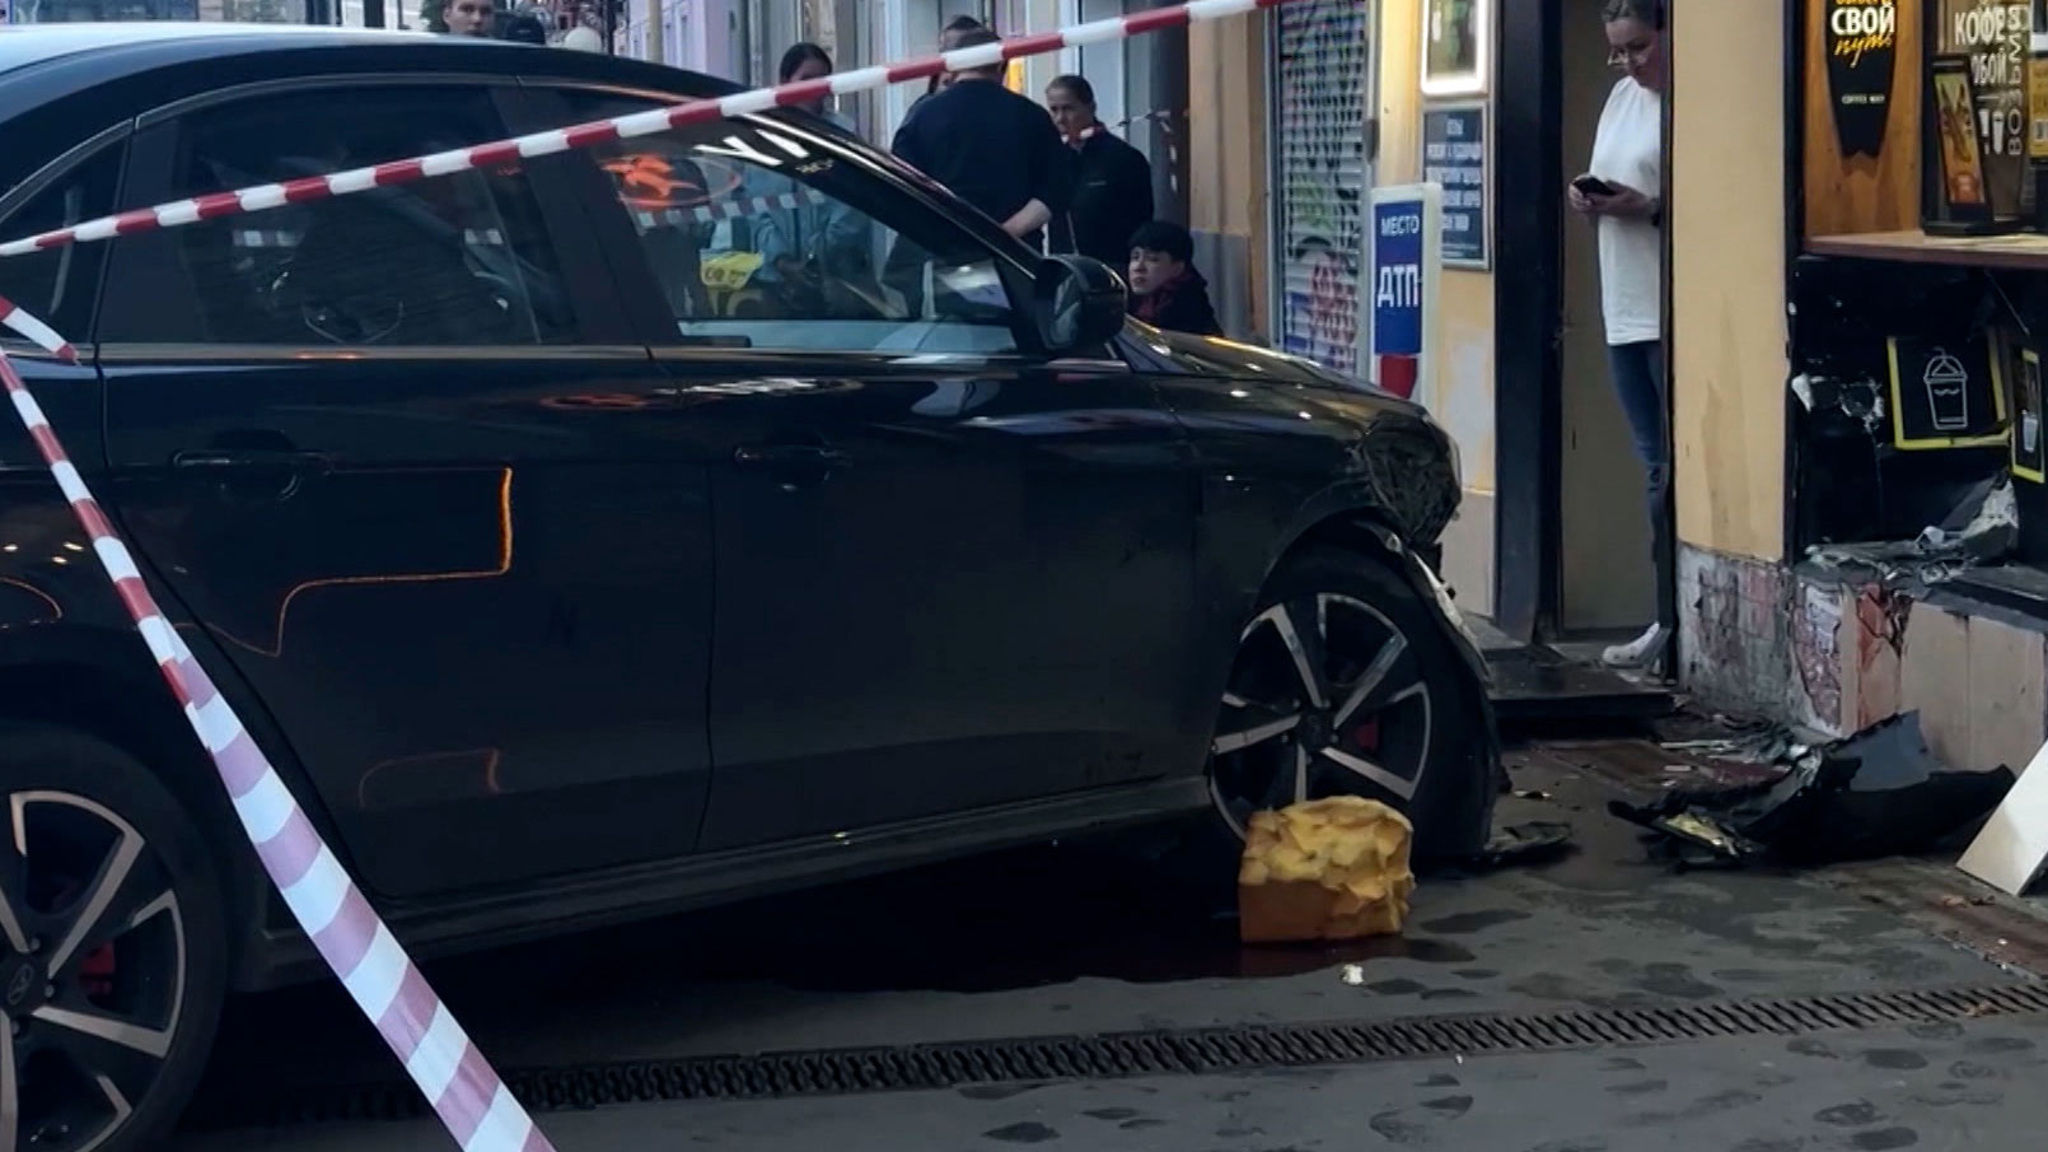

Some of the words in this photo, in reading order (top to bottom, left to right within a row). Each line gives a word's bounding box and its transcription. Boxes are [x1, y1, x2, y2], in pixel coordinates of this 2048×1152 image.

[1831, 4, 1895, 36] СВОЙ
[1954, 5, 2006, 46] КОФЕ
[1833, 35, 1893, 68] путь
[1381, 215, 1420, 237] МЕСТО
[1377, 263, 1419, 309] ДТП
